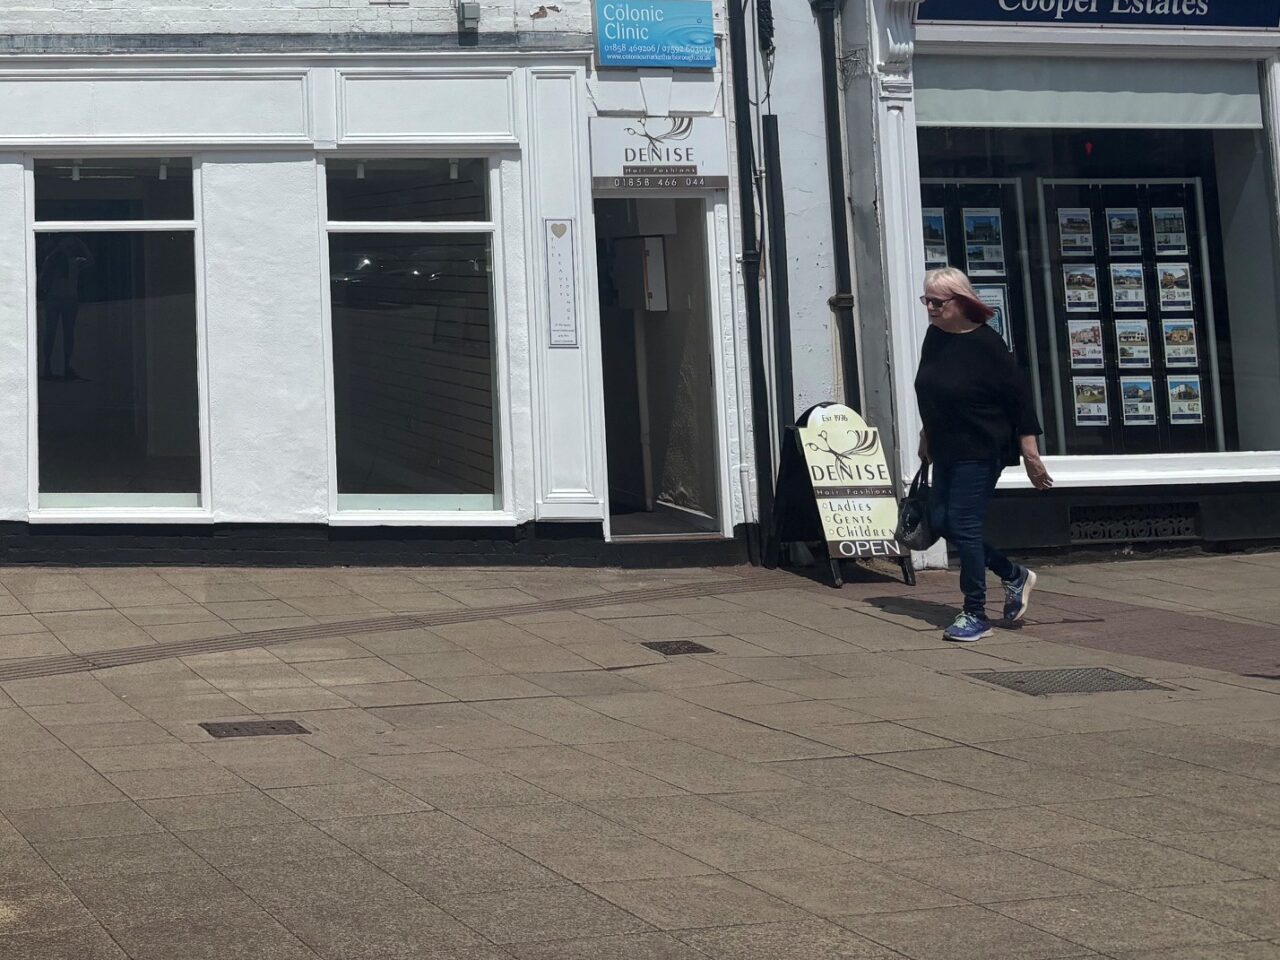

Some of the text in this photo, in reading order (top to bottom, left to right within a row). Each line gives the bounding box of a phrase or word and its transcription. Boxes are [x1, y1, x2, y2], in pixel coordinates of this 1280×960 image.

[603, 4, 664, 21] Colonic
[604, 23, 649, 40] Clinic
[624, 147, 695, 162] DENISE
[614, 177, 705, 187] 01858 466 044
[811, 464, 888, 481] DENISE
[839, 540, 901, 556] OPEN
